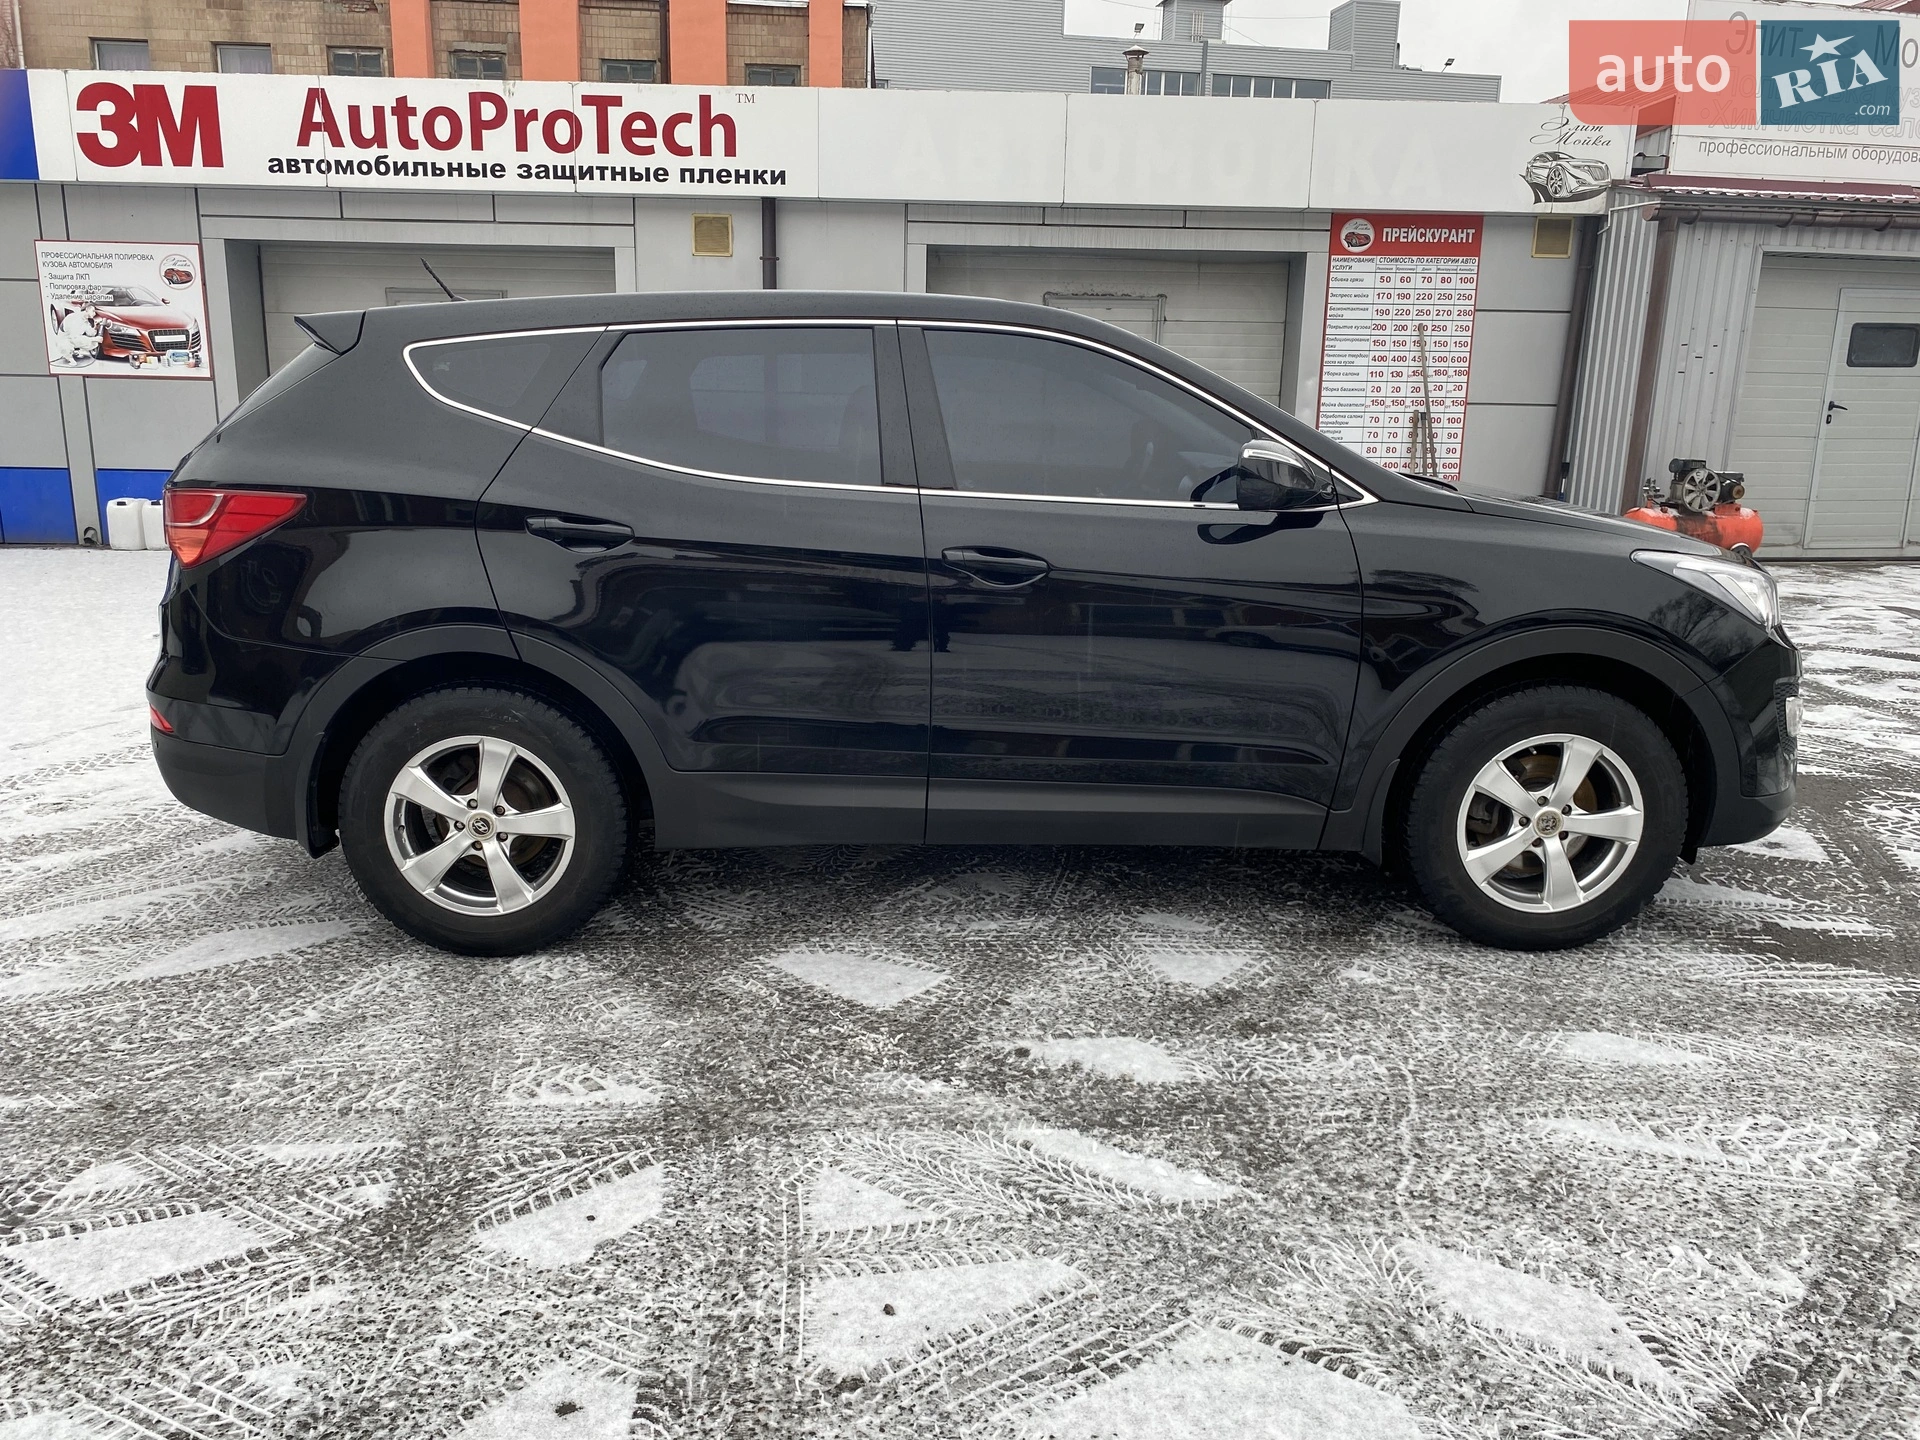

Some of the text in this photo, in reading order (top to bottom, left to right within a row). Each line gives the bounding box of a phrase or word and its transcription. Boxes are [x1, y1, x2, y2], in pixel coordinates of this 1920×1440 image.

[77, 82, 223, 168] 3M
[297, 88, 738, 157] AutoProTech
[1530, 131, 1611, 146] Мойка
[1698, 139, 1920, 165] профессиональным оборудов
[268, 152, 786, 186] автомобильные защитные пленки
[1383, 225, 1475, 243] ПРЕЙСКУРАНТ
[41, 251, 154, 261] ПРОФЕССИОНАЛЬНАЯ ПОЛИРОВКА
[48, 273, 74, 282] Защита
[49, 283, 102, 292] Полировка фар
[50, 293, 82, 301] Удаление
[1457, 309, 1473, 317] 280
[1413, 324, 1428, 332] 20
[1432, 324, 1447, 332] 250
[1433, 340, 1448, 348] 150
[1453, 340, 1468, 348] 150
[1371, 399, 1384, 407] 150
[1391, 399, 1405, 407] 150
[1442, 462, 1458, 470] 600
